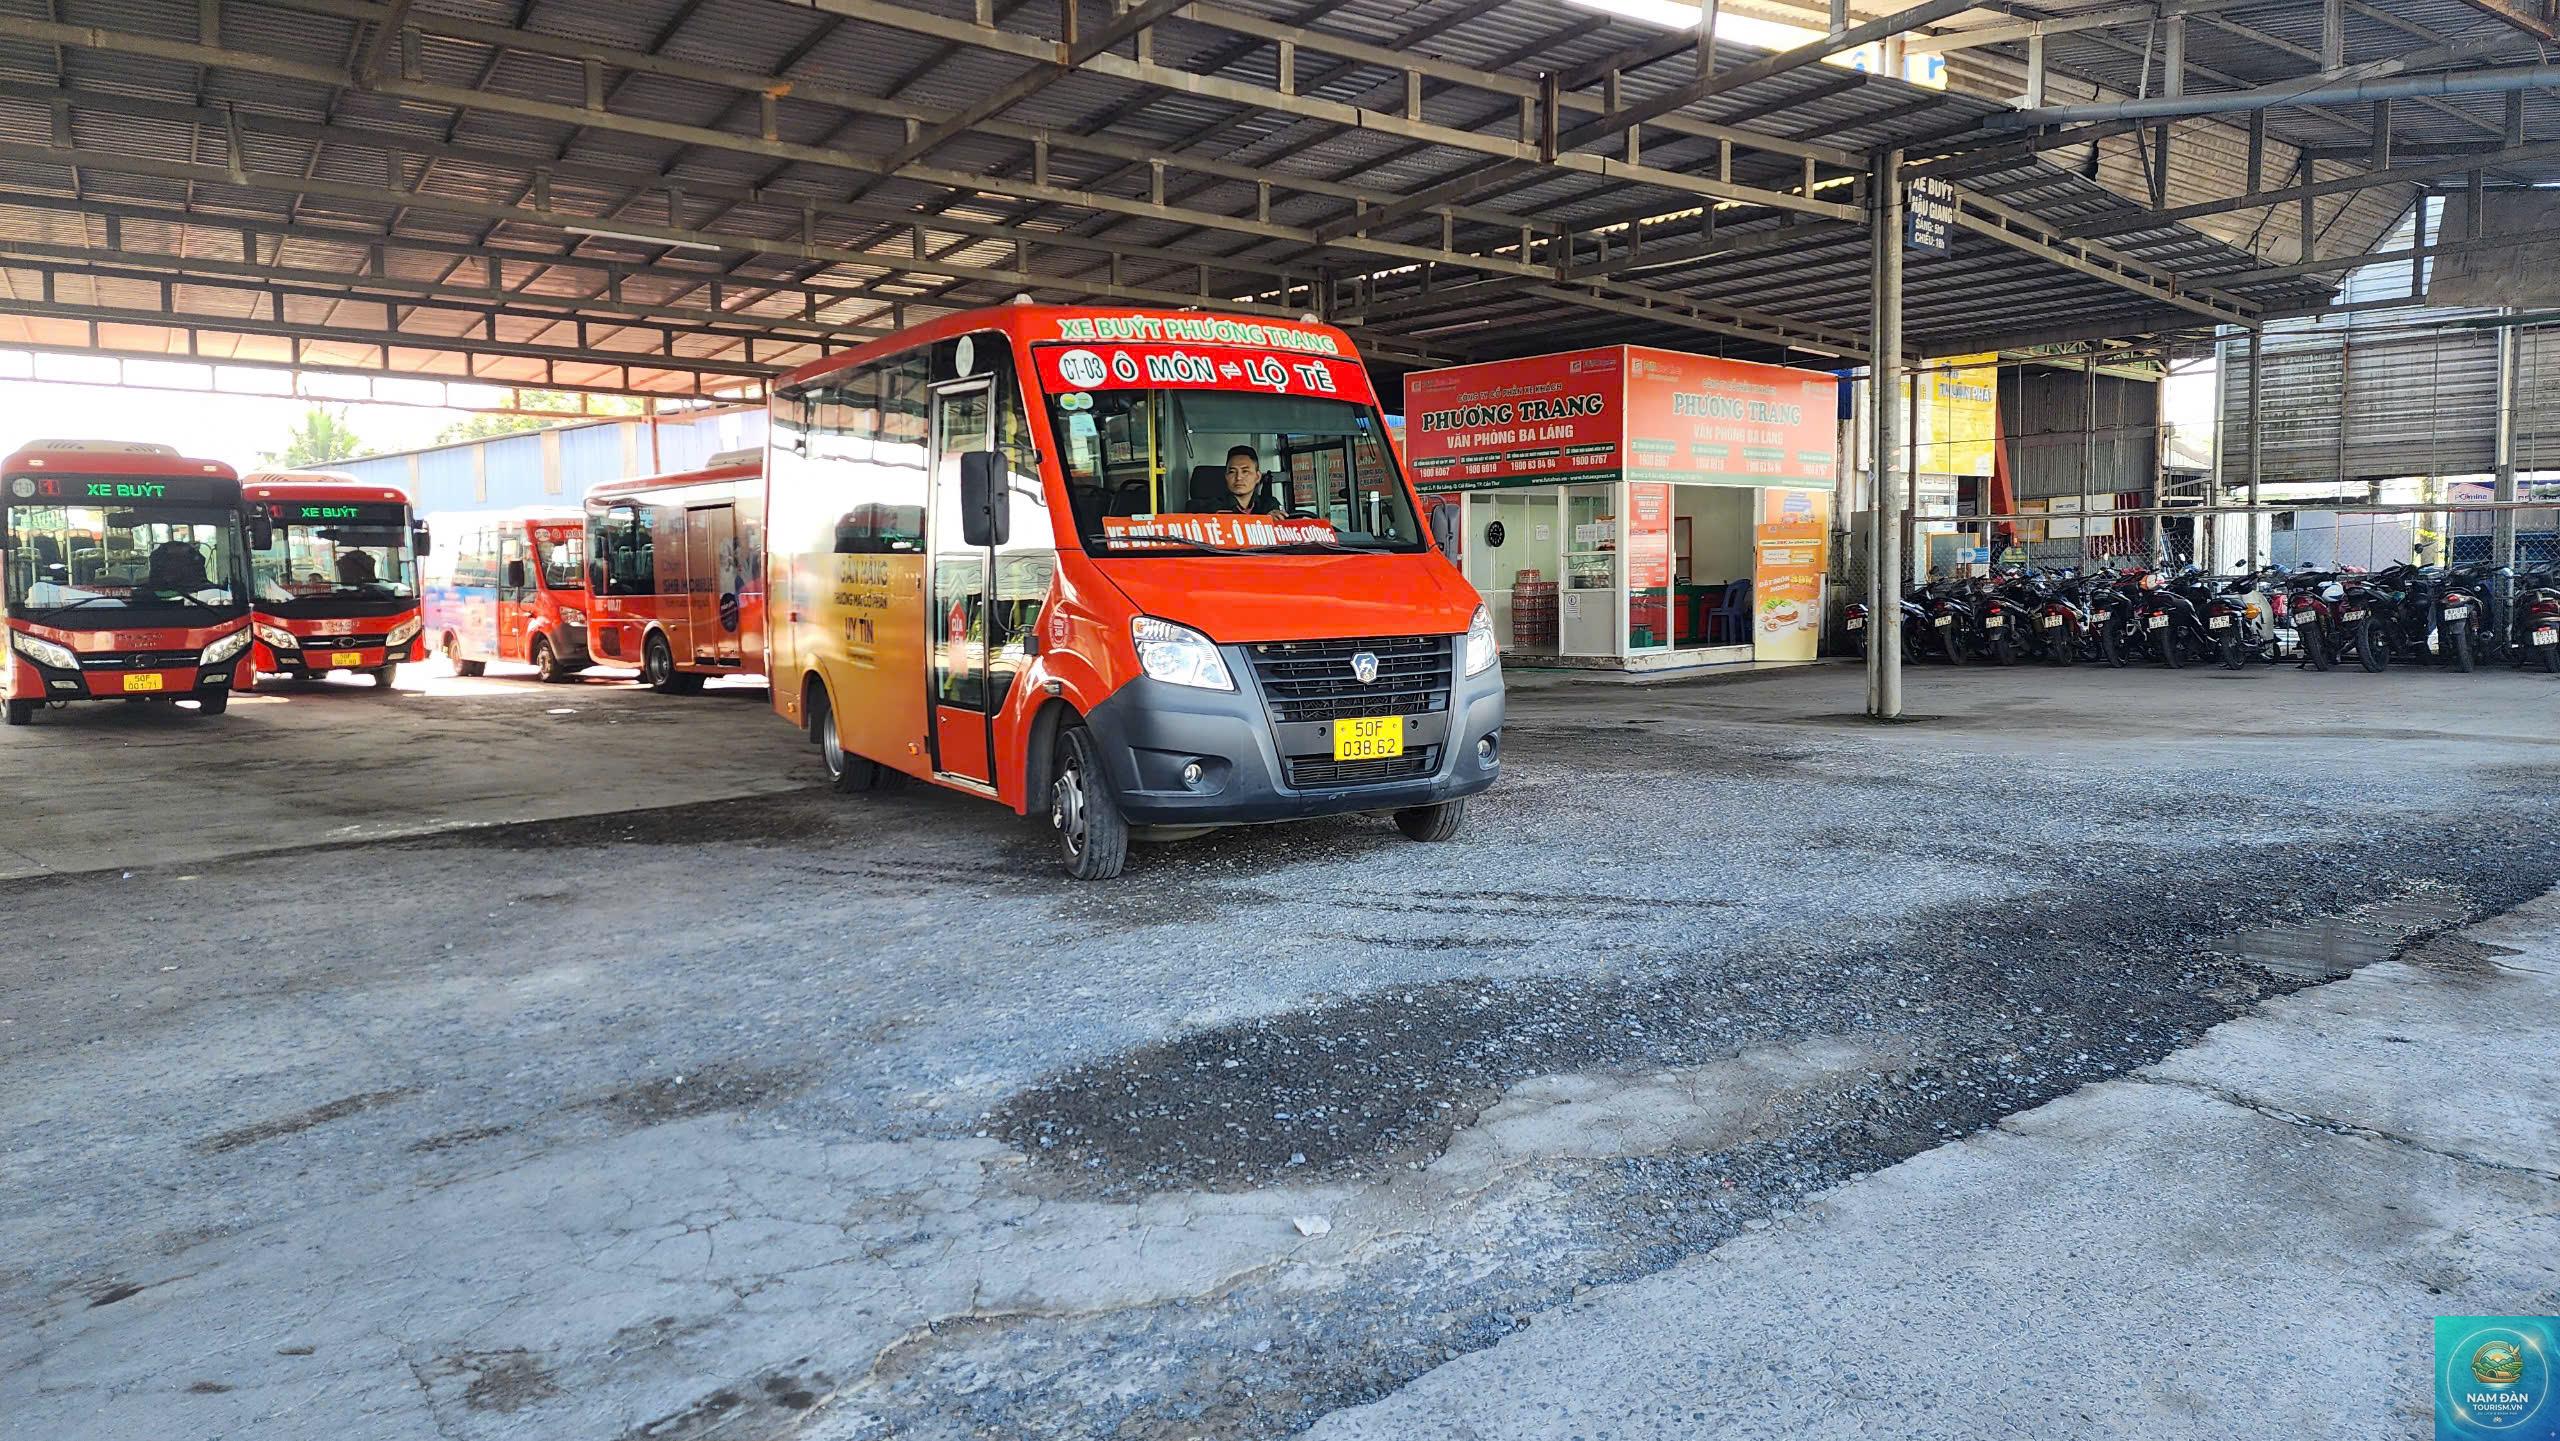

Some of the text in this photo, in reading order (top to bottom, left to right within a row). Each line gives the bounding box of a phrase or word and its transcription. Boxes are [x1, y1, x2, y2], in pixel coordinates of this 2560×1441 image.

[1928, 178, 1954, 202] BUÝT
[1911, 194, 1953, 224] HẬU GIANG
[1057, 315, 1338, 355] XE BUÝT PHƯƠNG TRANG
[1064, 350, 1103, 381] CT-03
[1112, 351, 1337, 393] Ô MÔN LỘ TẺ
[1422, 394, 1604, 432] PHƯƠNG TRANG
[1673, 392, 1801, 426] PHƯƠNG TRANG
[1447, 424, 1574, 449] VĂN PHÒNG BA LÁNG
[1465, 465, 1480, 474] 1900
[1511, 461, 1526, 470] 1900
[1572, 456, 1588, 466] 1900
[1420, 468, 1434, 478] 1900
[87, 482, 165, 497] XE BUÝT
[301, 505, 358, 518] XE BUÝT
[1204, 517, 1225, 545] TẺ
[1232, 519, 1245, 545] Ô
[1245, 519, 1277, 546] MÔN
[1274, 524, 1336, 543] TĂNG CƯỜNG
[1355, 720, 1383, 737] 50F
[1343, 738, 1396, 757] 038.62
